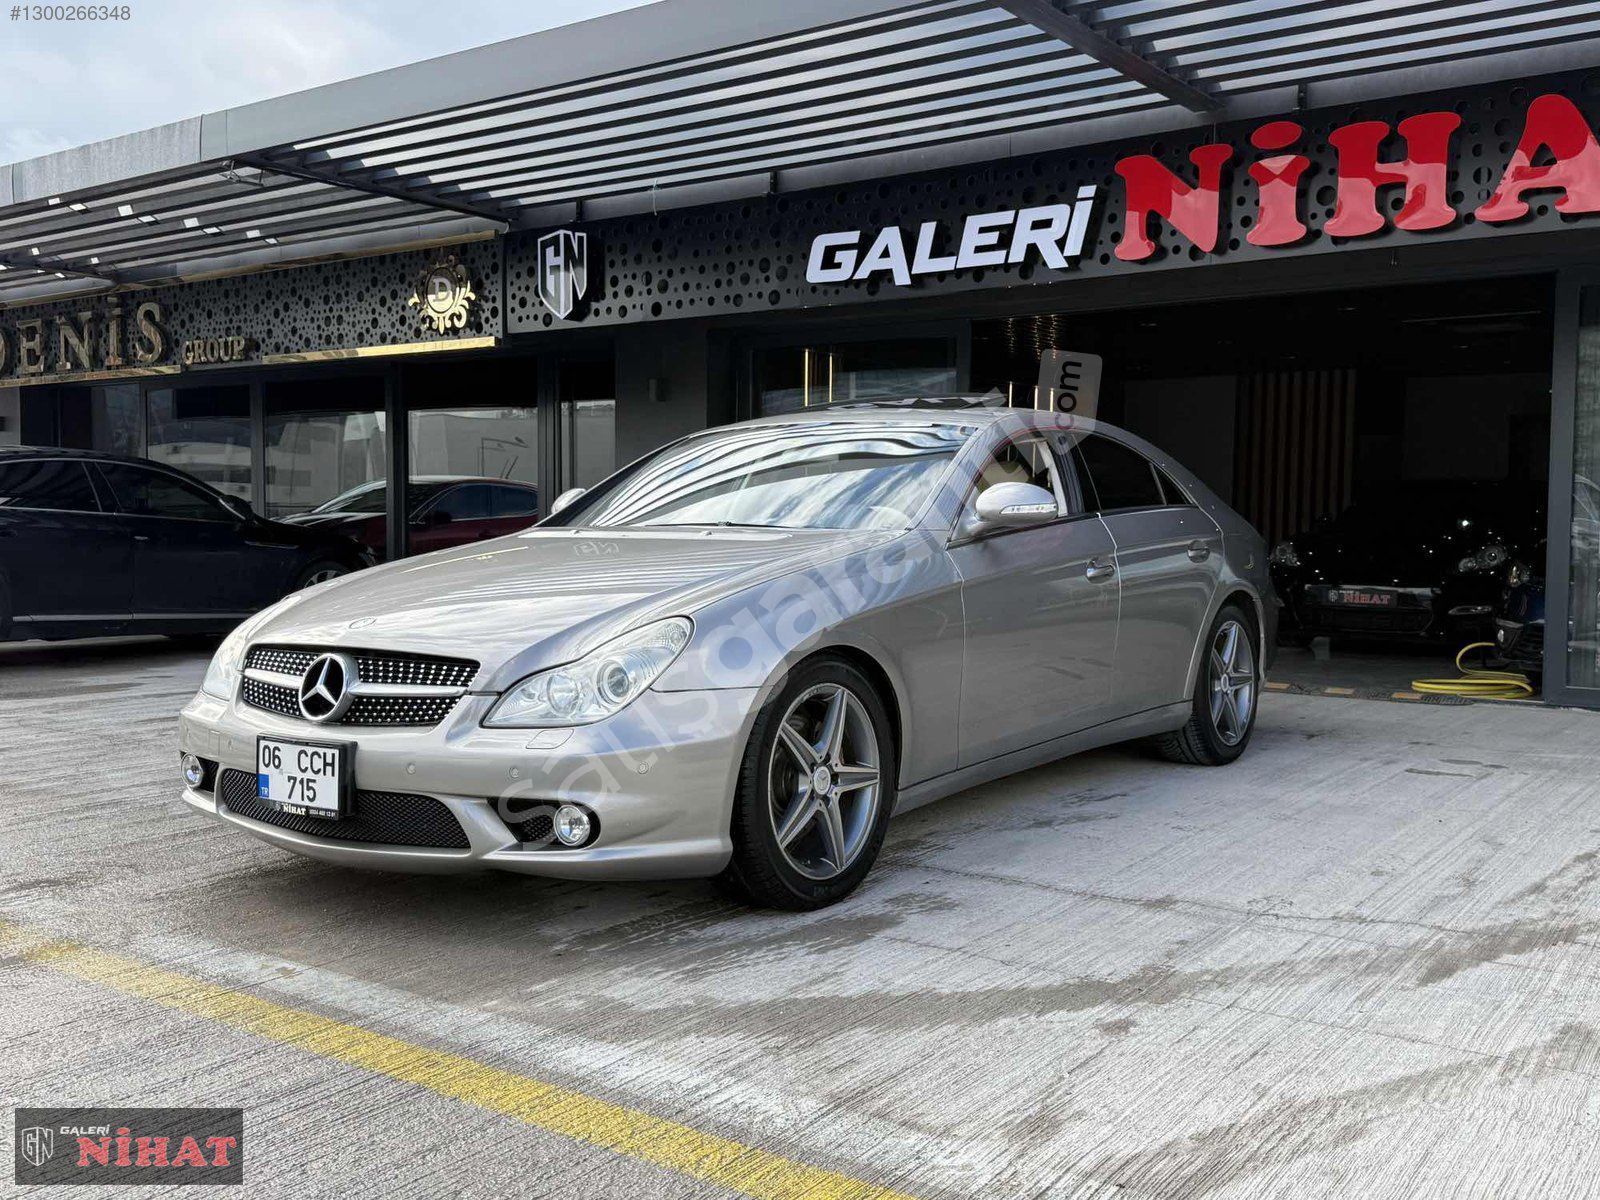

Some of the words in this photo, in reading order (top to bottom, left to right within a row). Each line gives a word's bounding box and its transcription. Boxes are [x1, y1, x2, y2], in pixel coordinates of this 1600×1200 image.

[806, 185, 1098, 287] GALERİ
[0, 297, 164, 376] ENİS
[182, 335, 246, 366] GROUP
[262, 744, 282, 770] 06
[297, 749, 336, 777] CCH
[287, 775, 317, 803] 715
